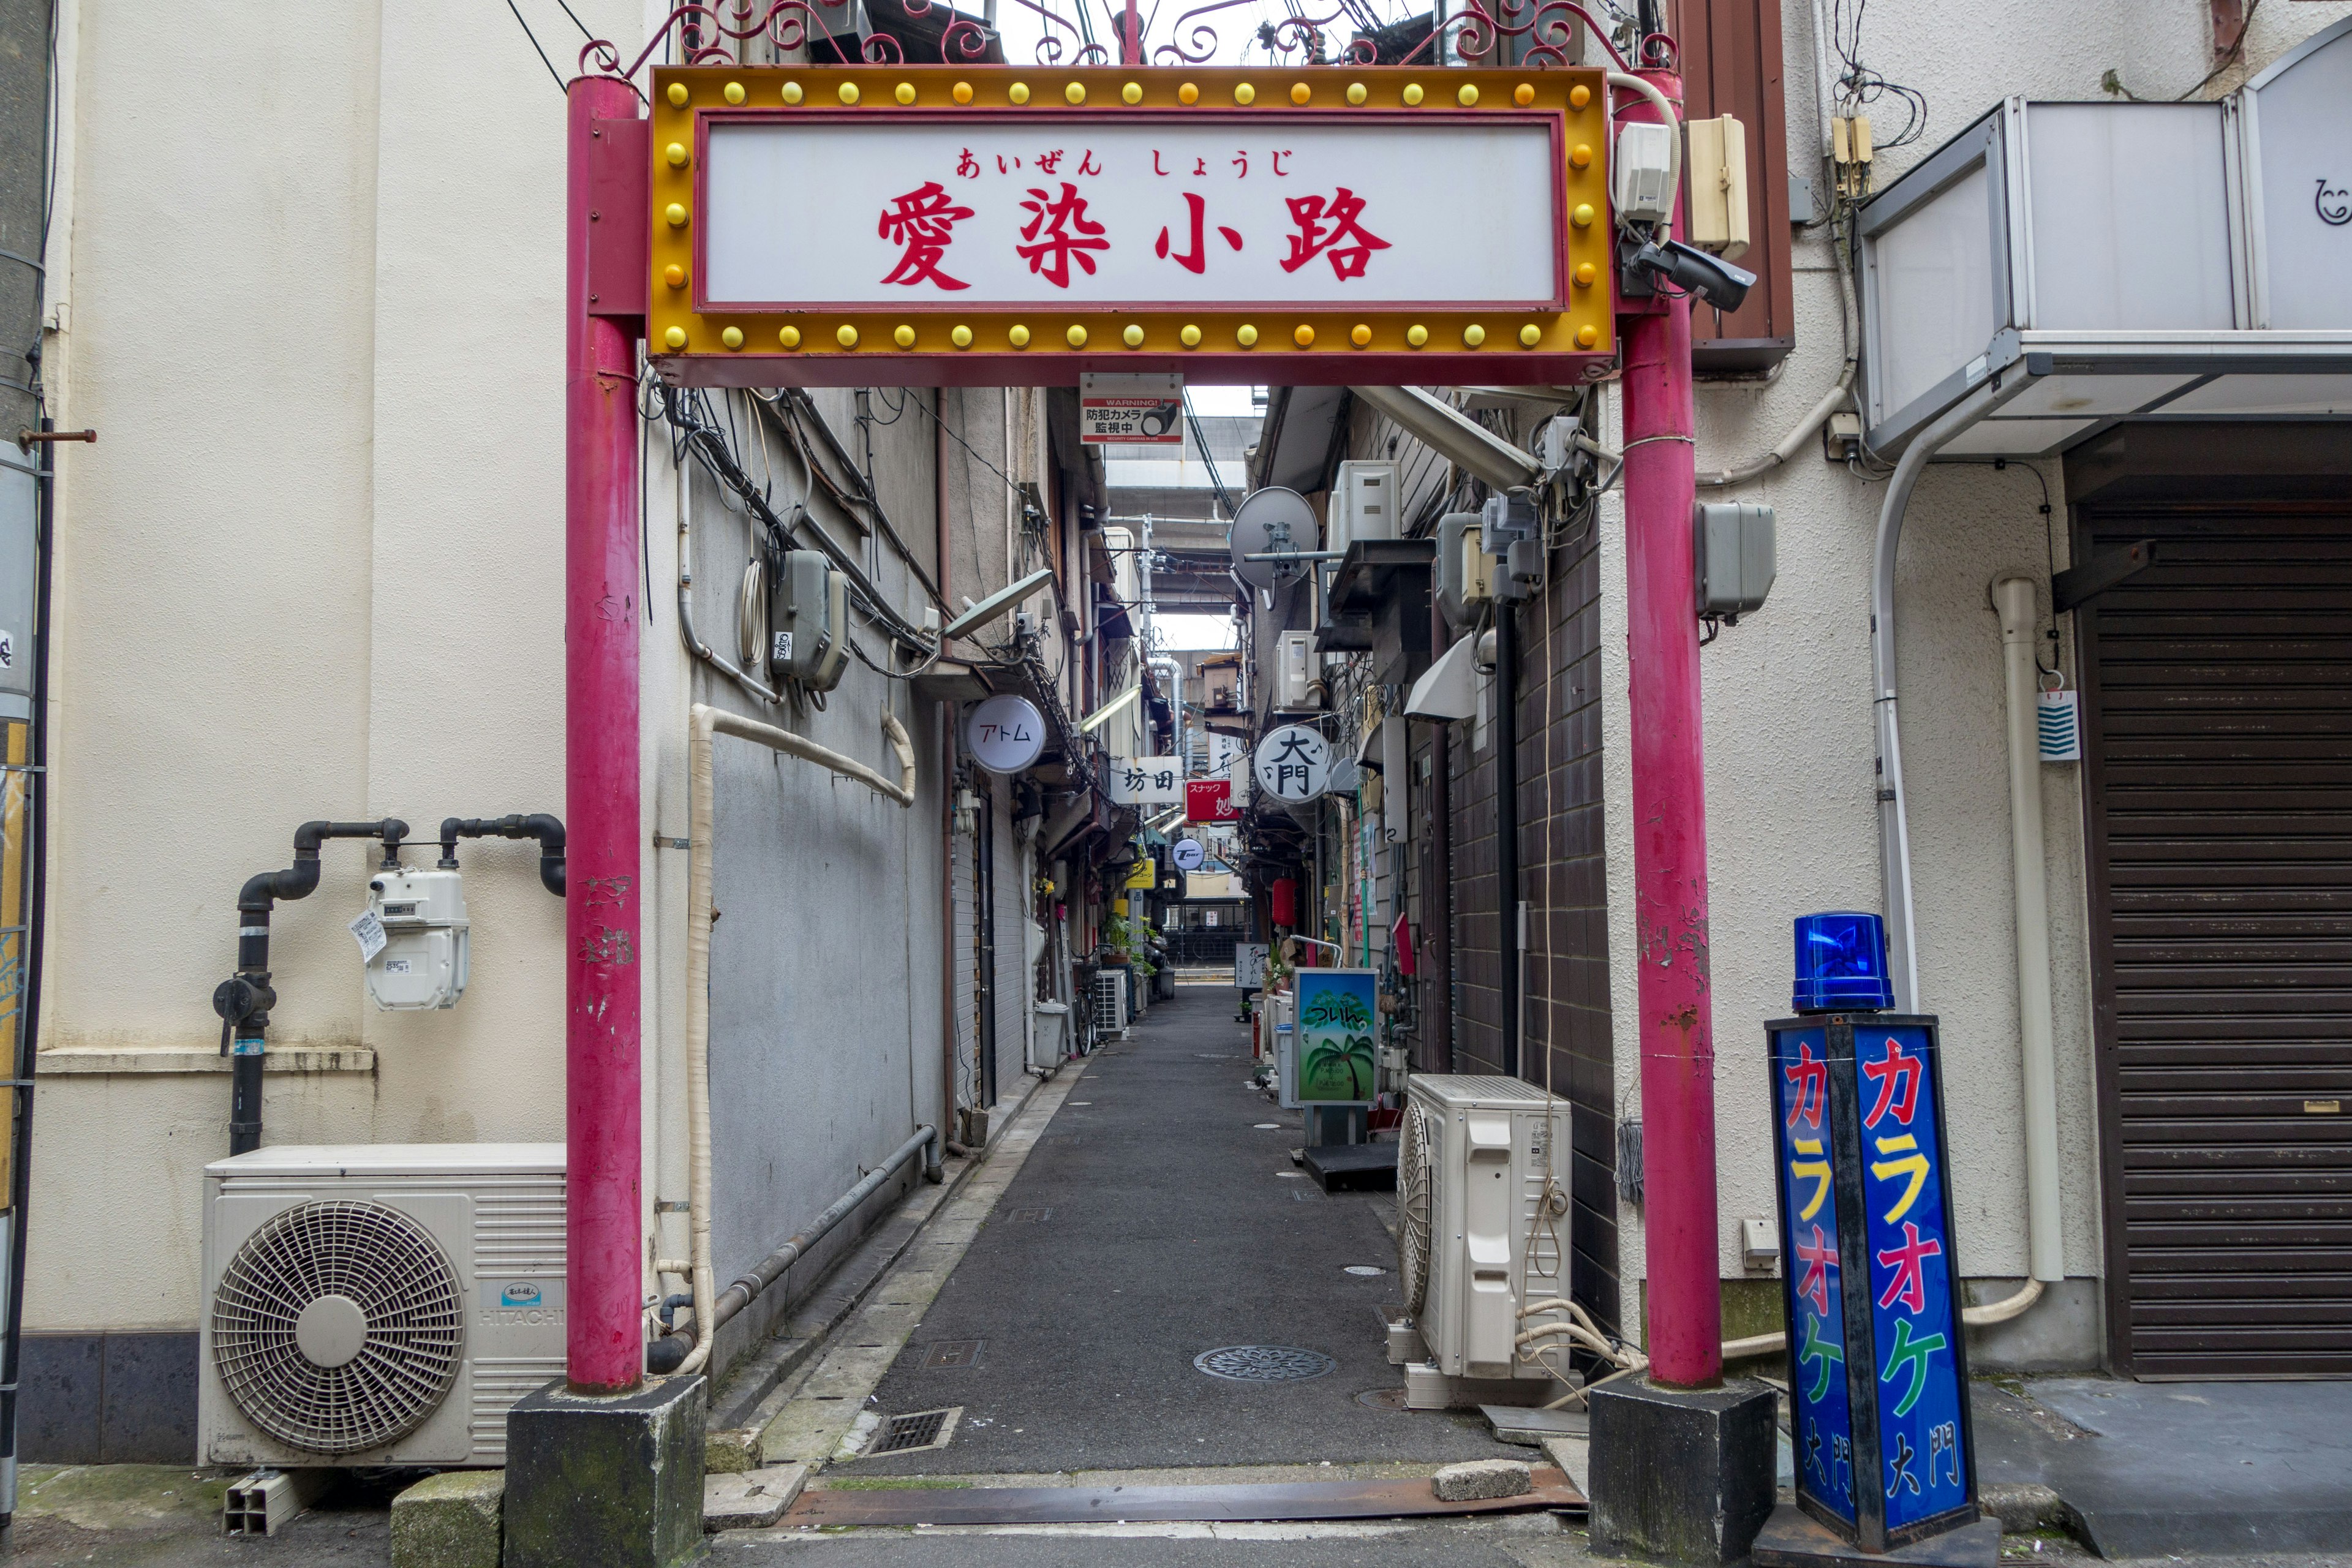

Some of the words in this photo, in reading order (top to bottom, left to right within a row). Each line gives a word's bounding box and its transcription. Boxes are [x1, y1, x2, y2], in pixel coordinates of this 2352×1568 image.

[957, 148, 1101, 179] あいぜん
[1152, 149, 1292, 178] しょうじ
[878, 181, 1393, 290] 愛染小路
[1087, 409, 1140, 420] 防犯カメラ
[1095, 422, 1133, 434] 監視中
[980, 724, 1030, 742] アトム
[1270, 730, 1317, 796] 大門
[1125, 767, 1174, 792] 坊田
[1190, 784, 1221, 793] スナック
[1216, 797, 1234, 816] 妙
[1311, 1006, 1364, 1023] ついん
[1785, 1041, 1844, 1404] カラオケ
[1862, 1036, 1947, 1418] カラオケ
[479, 1310, 564, 1326] HITACHI
[1804, 1416, 1855, 1508] 大門
[1887, 1420, 1960, 1499] 大門
